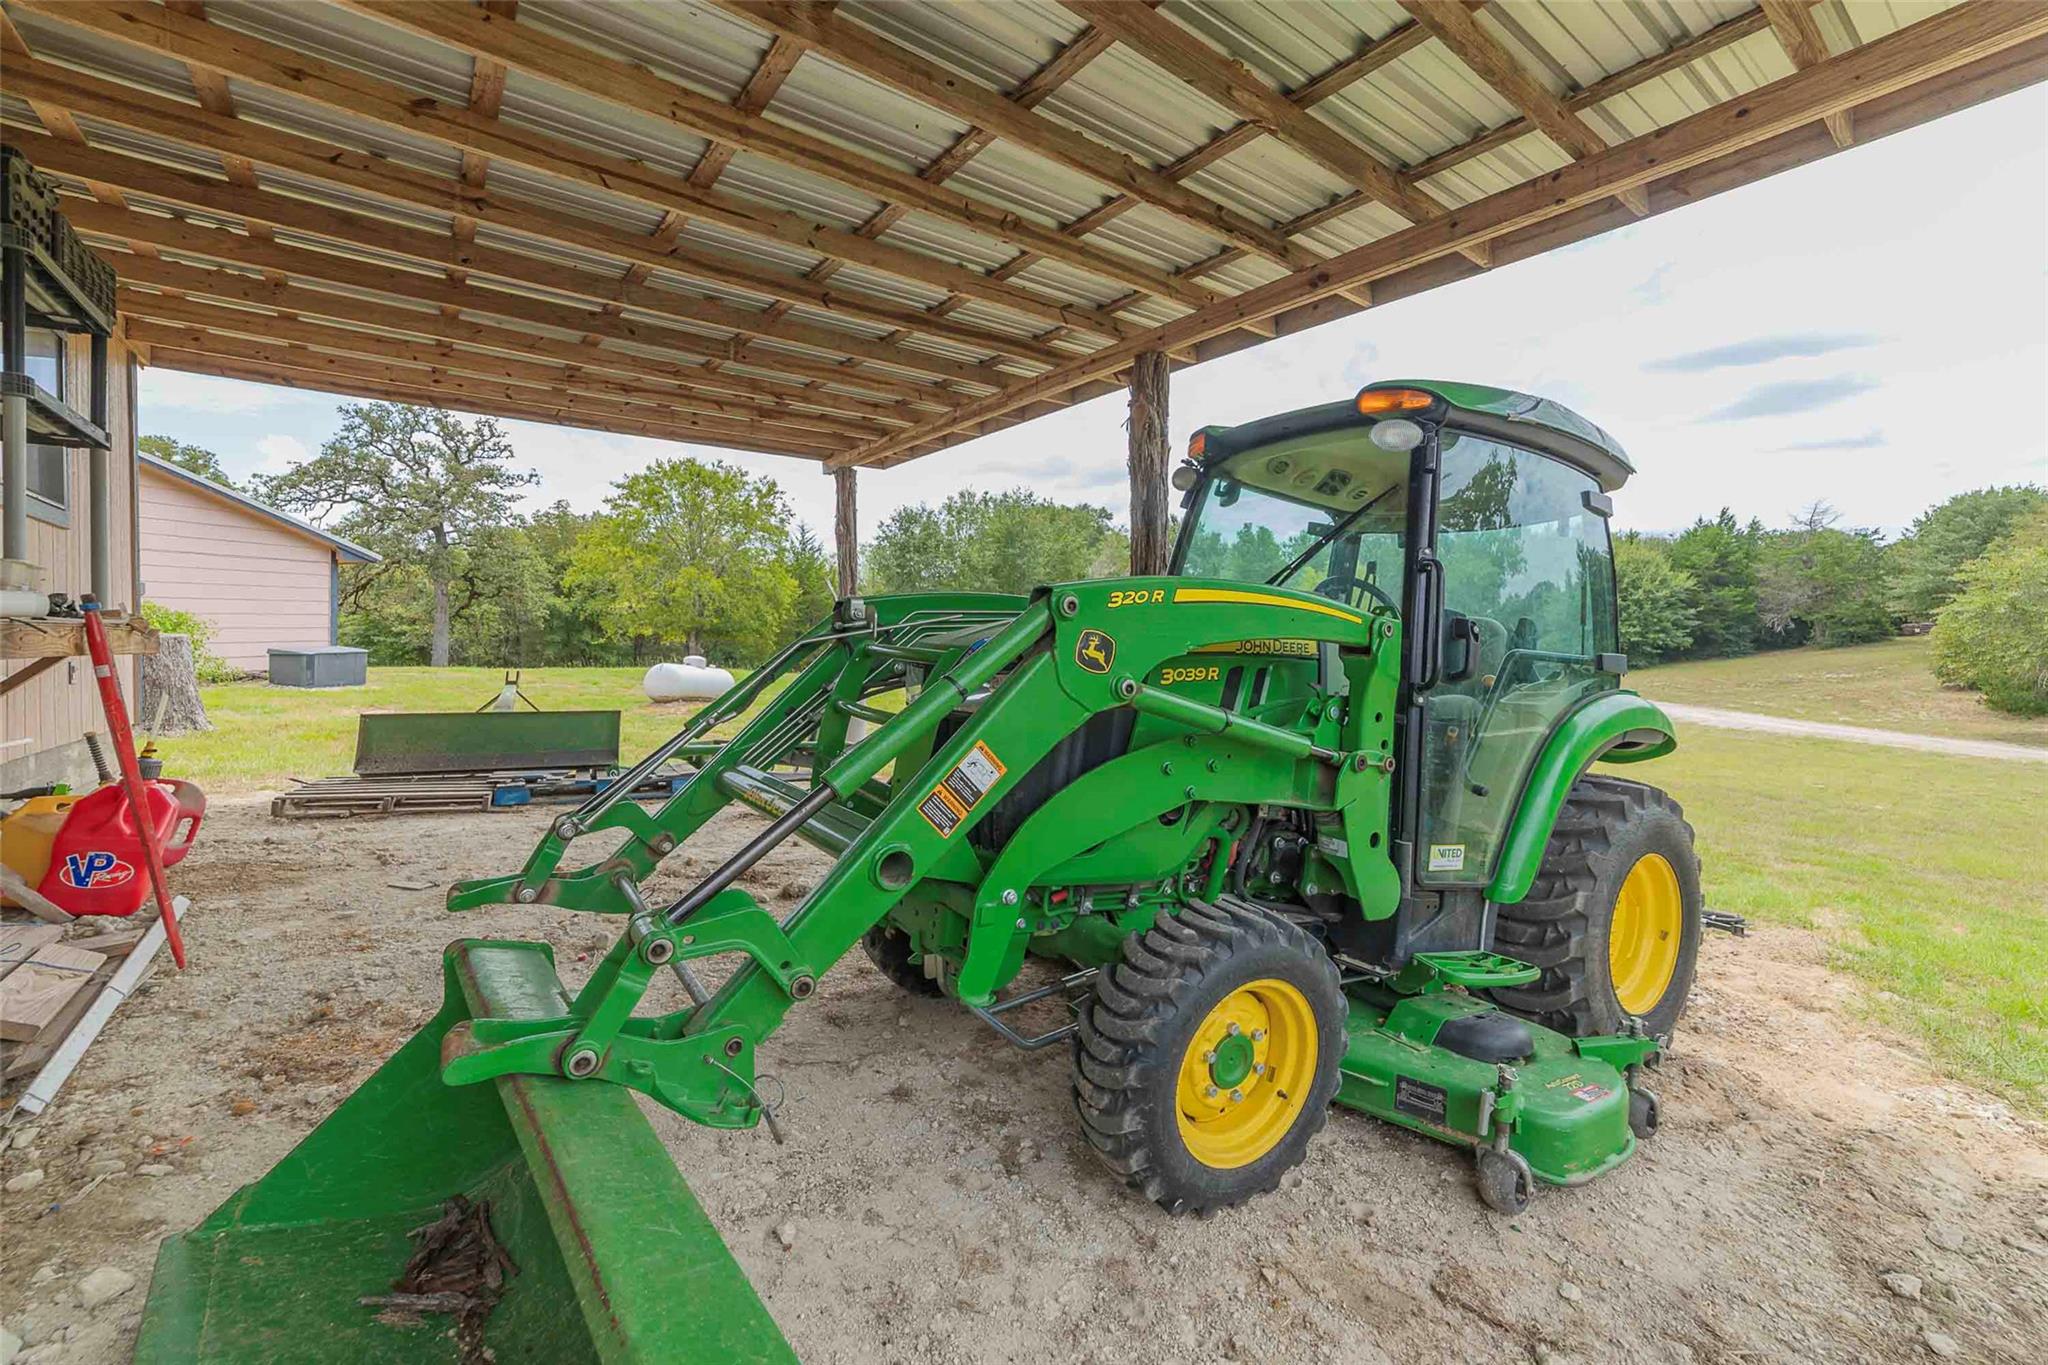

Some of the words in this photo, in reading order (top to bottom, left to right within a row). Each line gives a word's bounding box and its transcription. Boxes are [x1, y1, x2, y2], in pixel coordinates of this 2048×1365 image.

[1108, 590, 1149, 608] 320
[1151, 589, 1165, 603] R
[1235, 640, 1271, 652] JOHN
[1273, 639, 1310, 654] DEERE
[1160, 667, 1206, 685] 3039
[1207, 666, 1219, 681] R
[66, 851, 116, 888] VP
